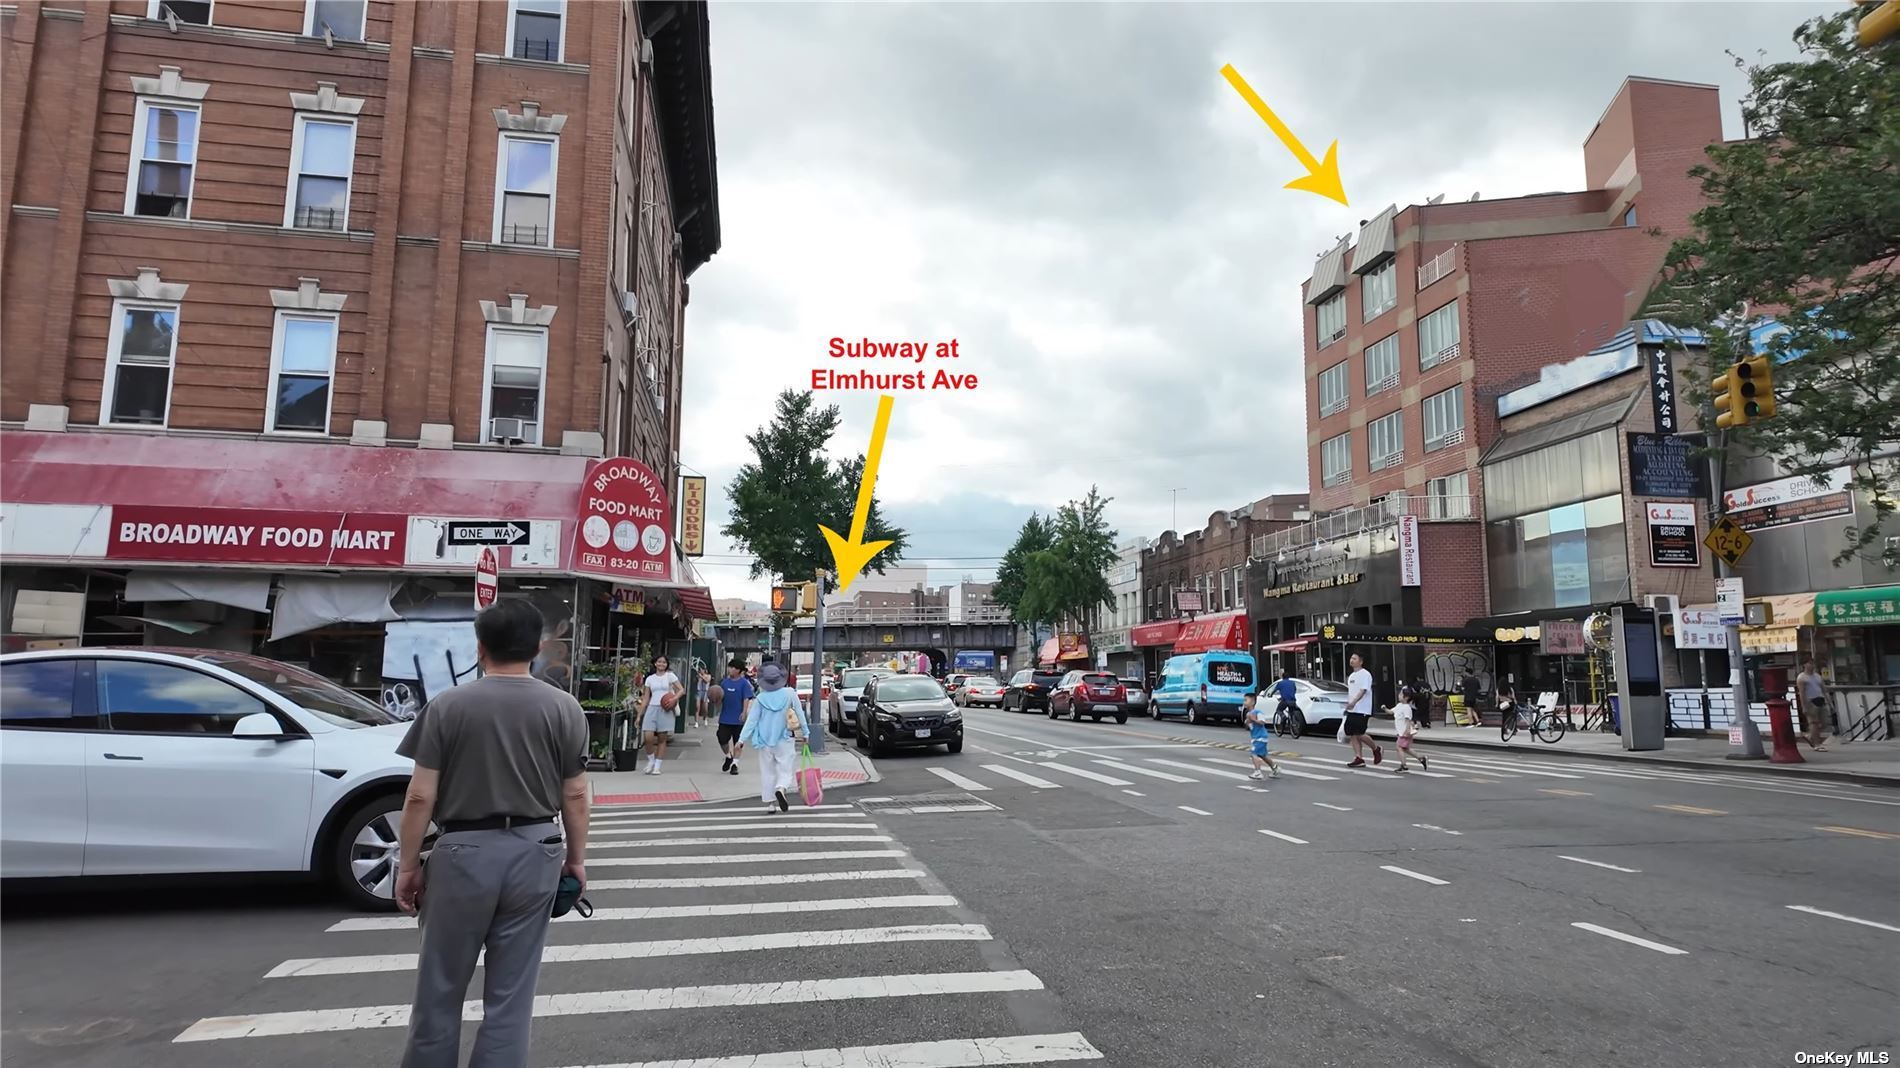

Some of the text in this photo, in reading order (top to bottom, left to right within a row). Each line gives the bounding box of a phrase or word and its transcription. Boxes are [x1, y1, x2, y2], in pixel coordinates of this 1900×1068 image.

[1636, 435, 1656, 446] Blue
[1647, 454, 1686, 463] TAXATION
[1648, 461, 1687, 469] AUDITING
[1643, 468, 1693, 477] ACCOUNTING
[593, 466, 662, 504] BROADWAY
[589, 498, 663, 521] FOOD MART
[686, 482, 701, 539] LIQUORS
[119, 522, 395, 550] BROADWAY FOOD MART
[460, 528, 518, 539] ONE WAY
[1714, 535, 1743, 550] 12-6
[1402, 516, 1415, 585] Nangma Restaurant
[585, 555, 662, 572] FAX 83-20 ATM
[480, 587, 493, 599] ENTER
[614, 588, 644, 603] ATM
[1263, 585, 1291, 599] Nangma
[1292, 577, 1334, 593] Restaurant
